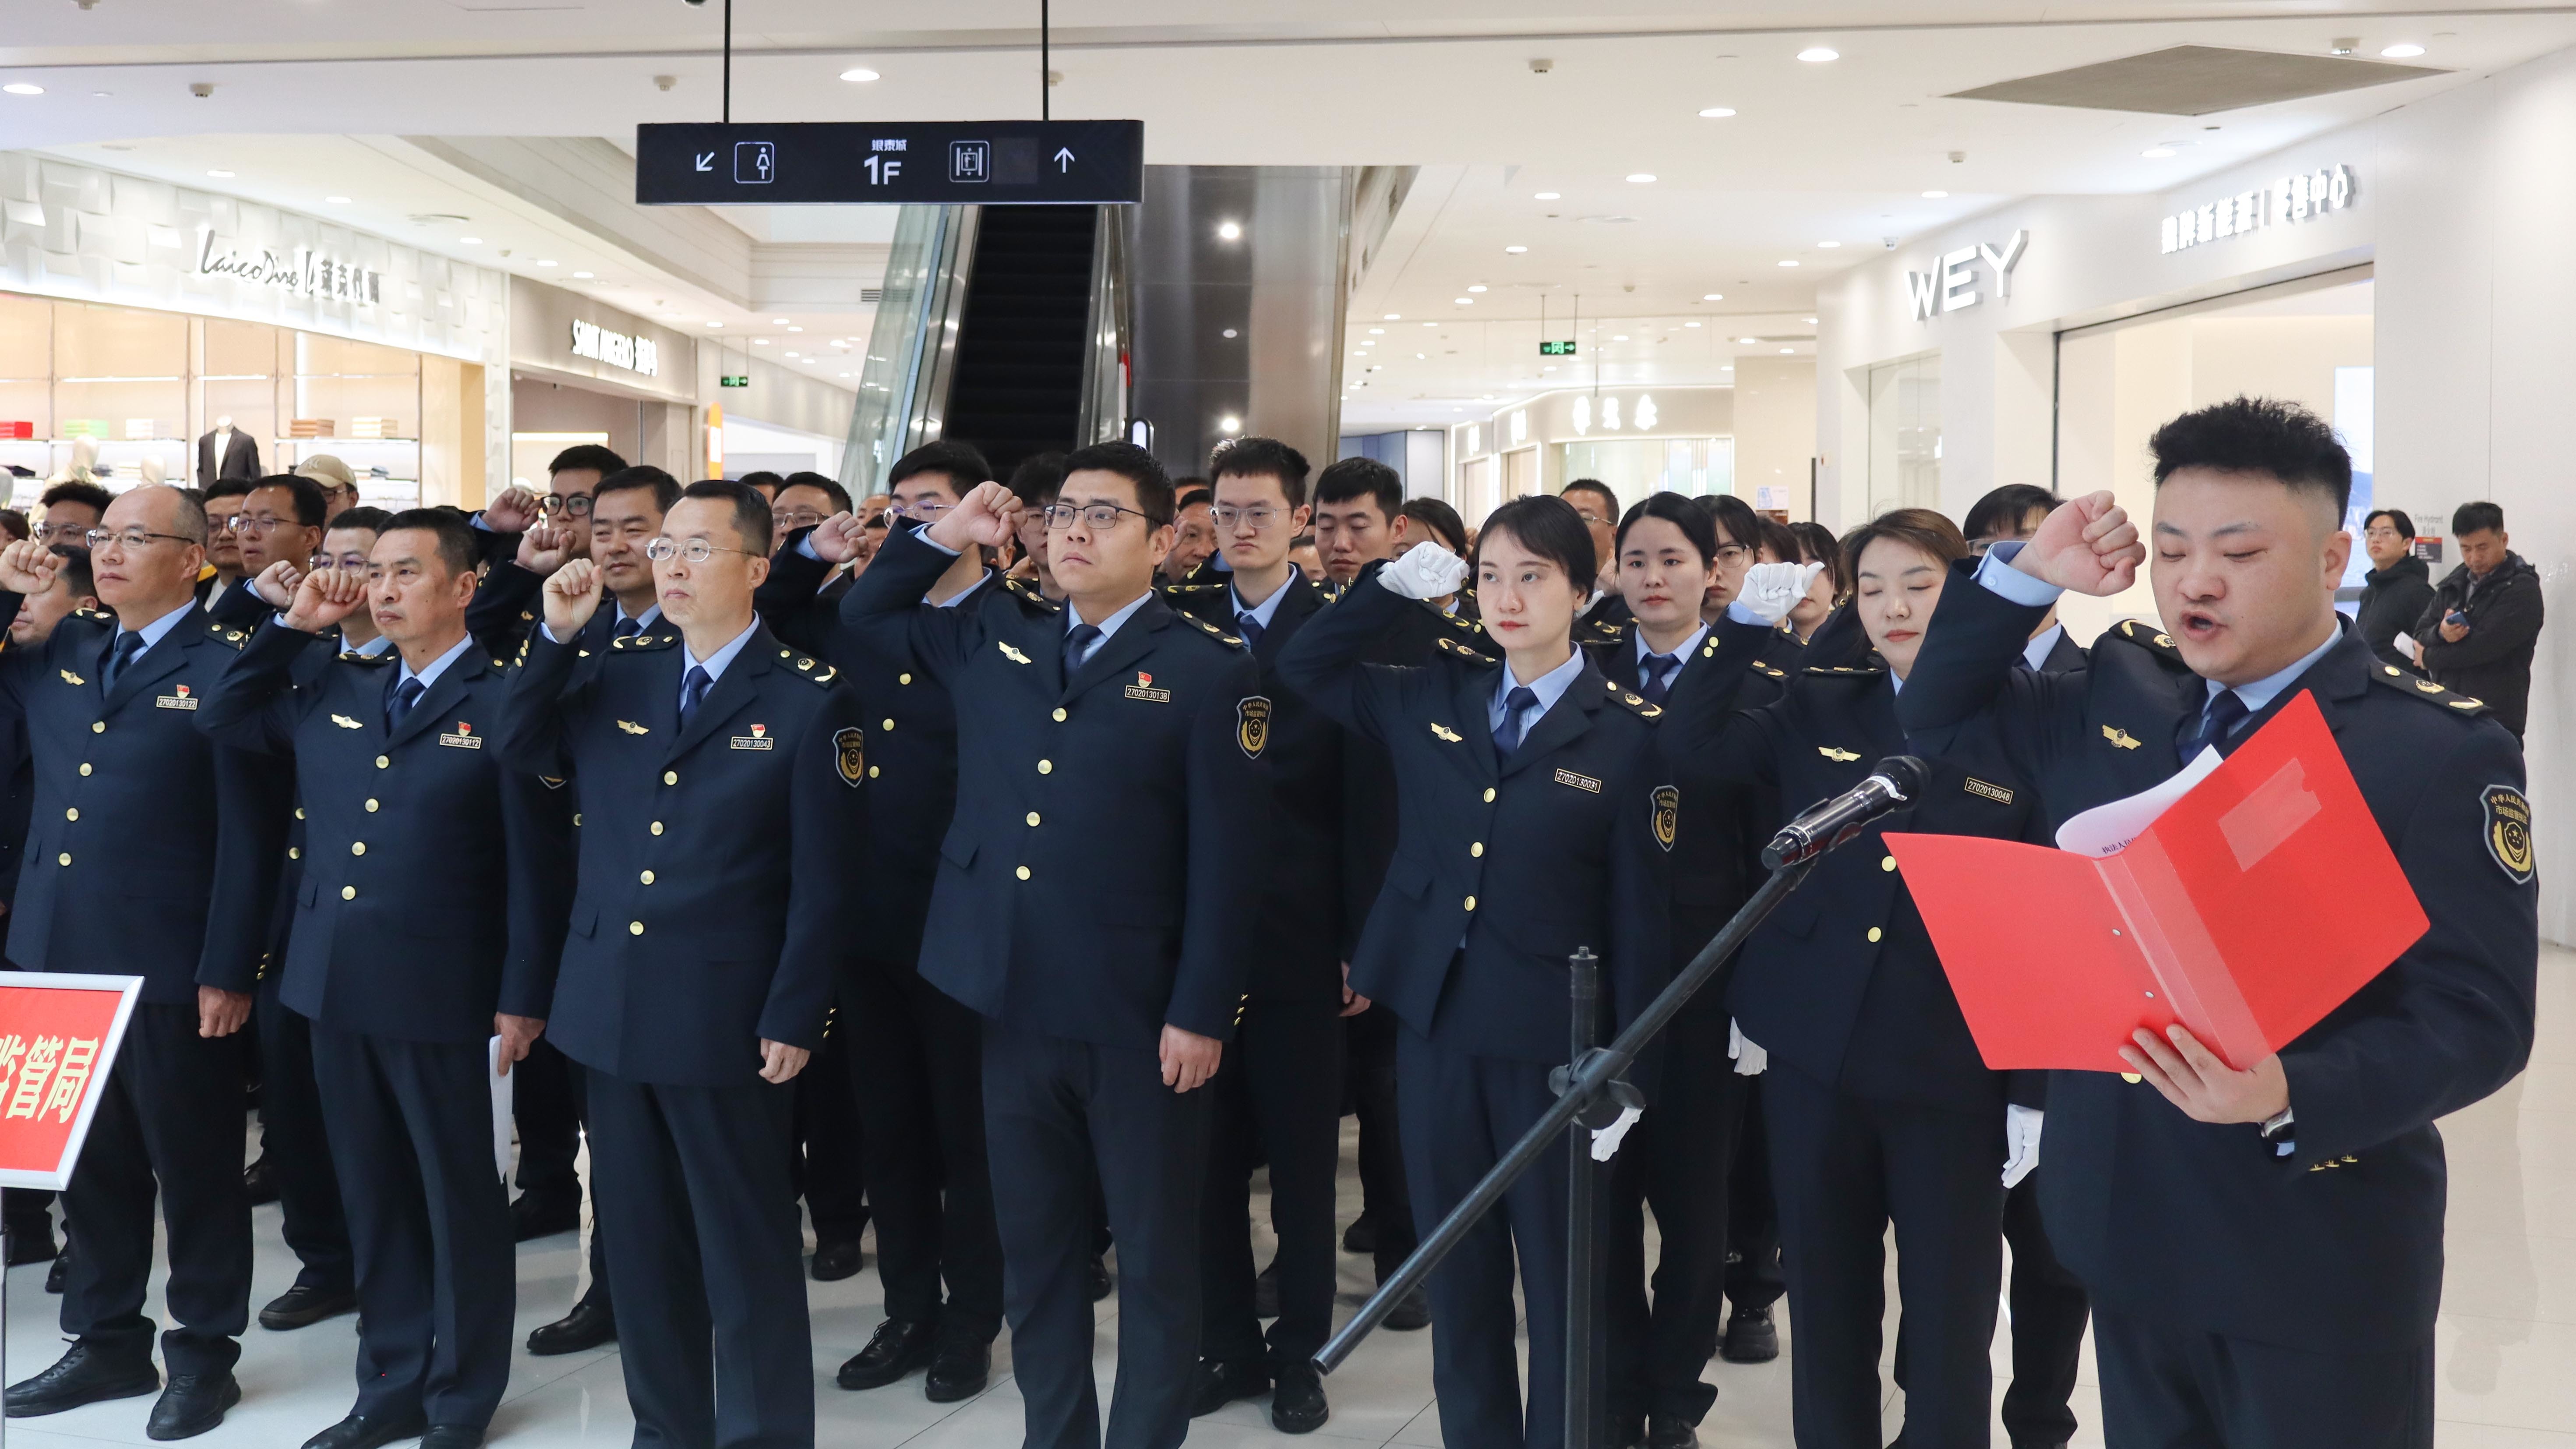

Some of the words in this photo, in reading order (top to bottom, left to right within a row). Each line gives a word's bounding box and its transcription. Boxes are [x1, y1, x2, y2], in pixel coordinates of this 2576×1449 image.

[864, 154, 902, 185] 1F
[1903, 228, 2028, 322] WEY
[1127, 688, 1168, 700] 27020130138
[159, 698, 196, 708] 27020130122
[442, 736, 480, 747] 27020130112
[732, 739, 771, 748] 27020130043
[1556, 771, 1599, 791] 27020130031
[1967, 780, 2011, 802] 27020130048
